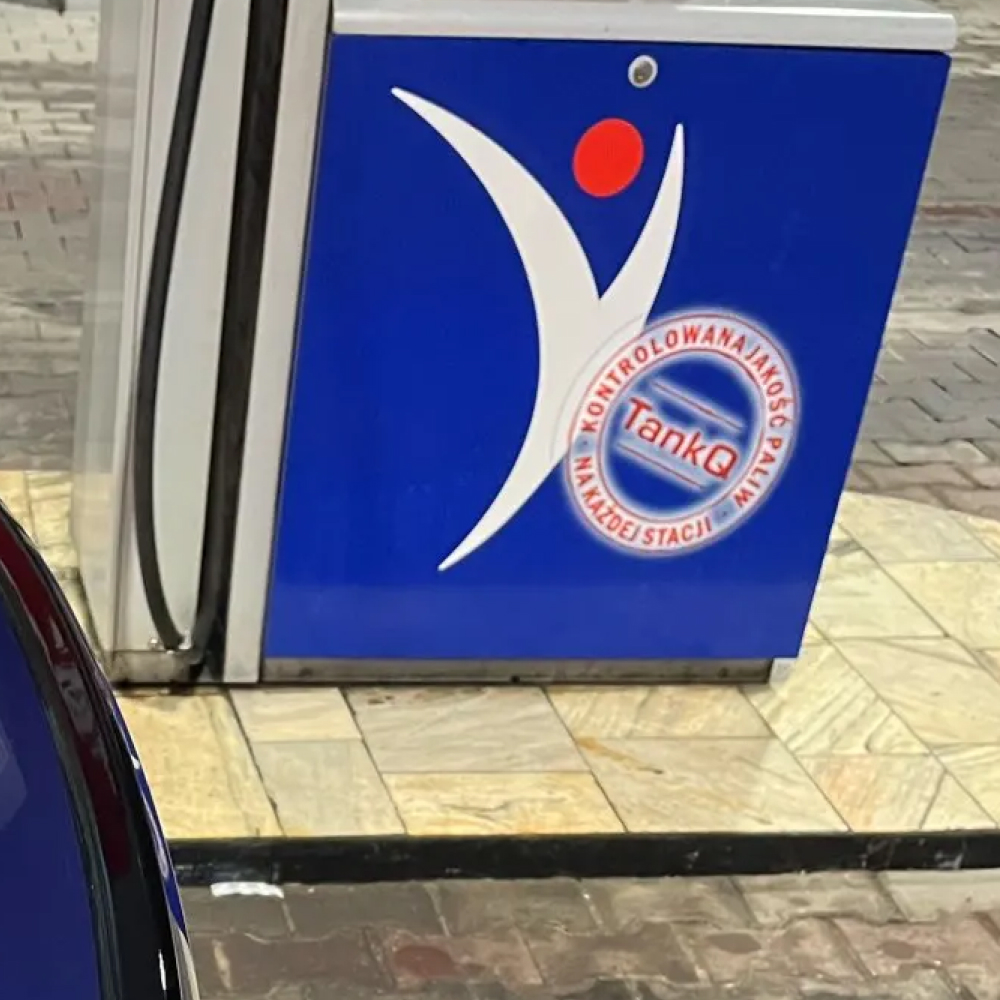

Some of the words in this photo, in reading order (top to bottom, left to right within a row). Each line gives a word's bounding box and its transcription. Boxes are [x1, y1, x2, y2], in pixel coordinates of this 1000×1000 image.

[581, 324, 746, 433] KONTROLOWANA
[746, 346, 791, 428] JAKOŚĆ
[623, 397, 739, 479] TankQ
[733, 437, 782, 507] PALIW
[574, 456, 592, 487] NA
[583, 487, 641, 542] KAŻDEJ
[644, 516, 712, 545] STACJI
